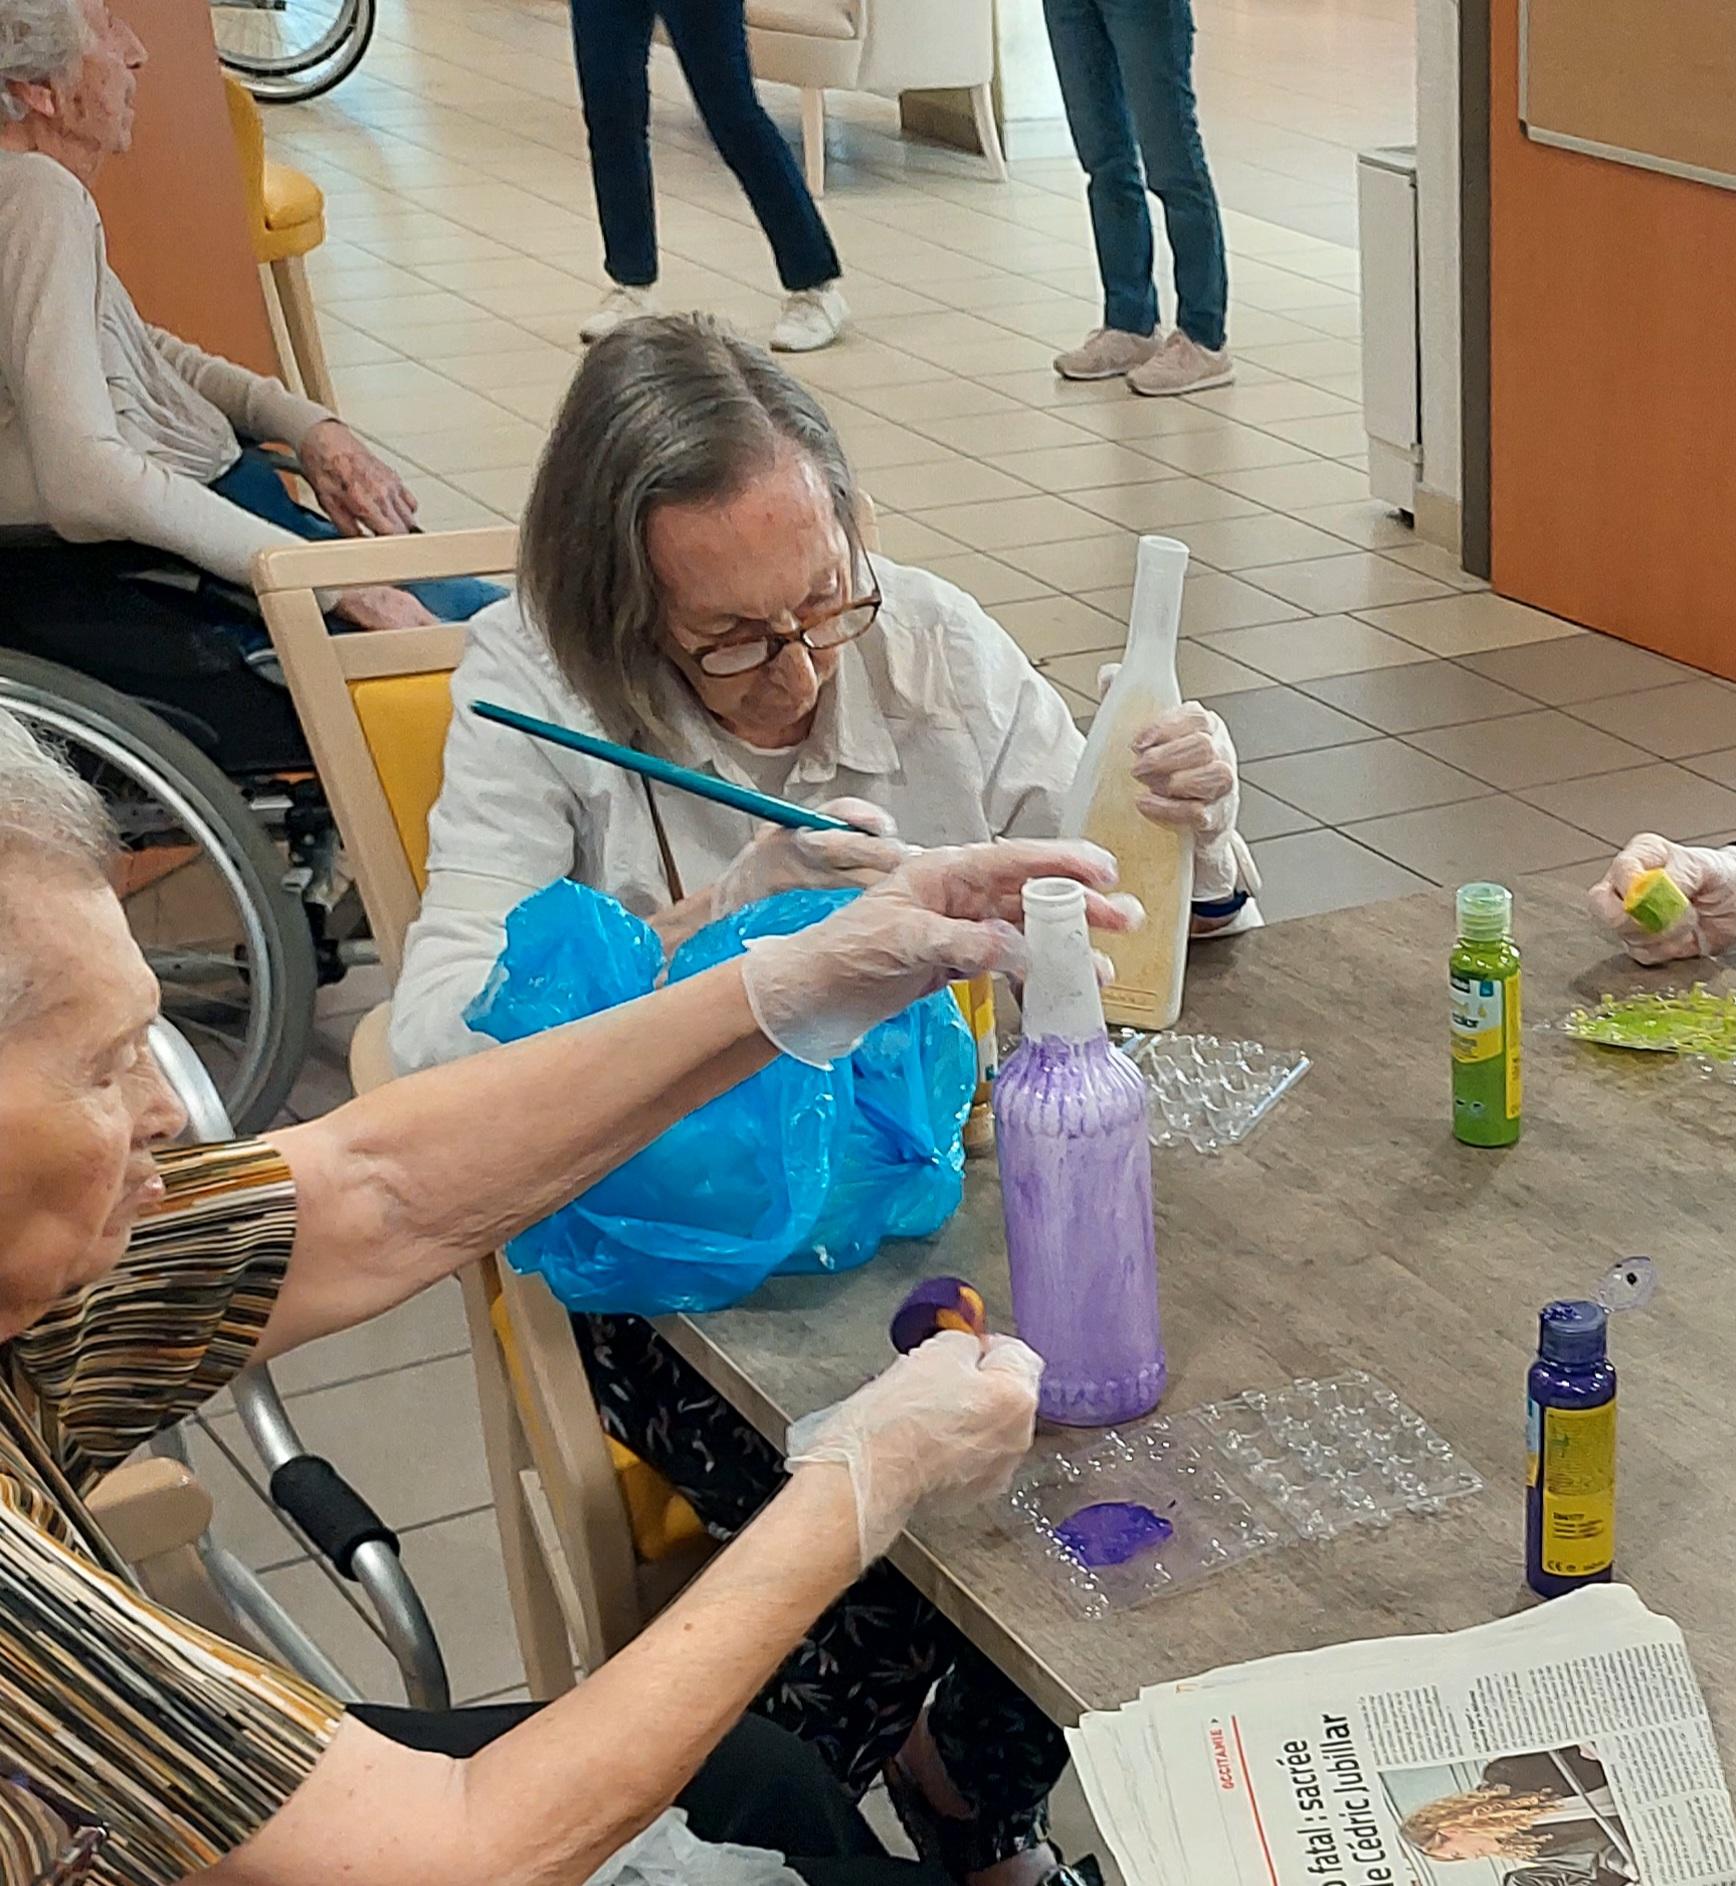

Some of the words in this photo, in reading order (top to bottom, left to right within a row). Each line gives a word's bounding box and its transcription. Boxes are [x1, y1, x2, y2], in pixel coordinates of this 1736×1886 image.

[1210, 1728, 1235, 1790] OCCITANIE
[1276, 1740, 1324, 1811] sacrée
[1319, 1713, 1371, 1794] Jubillar
[1296, 1827, 1343, 1874] fatal
[1338, 1798, 1387, 1864] Cédric
